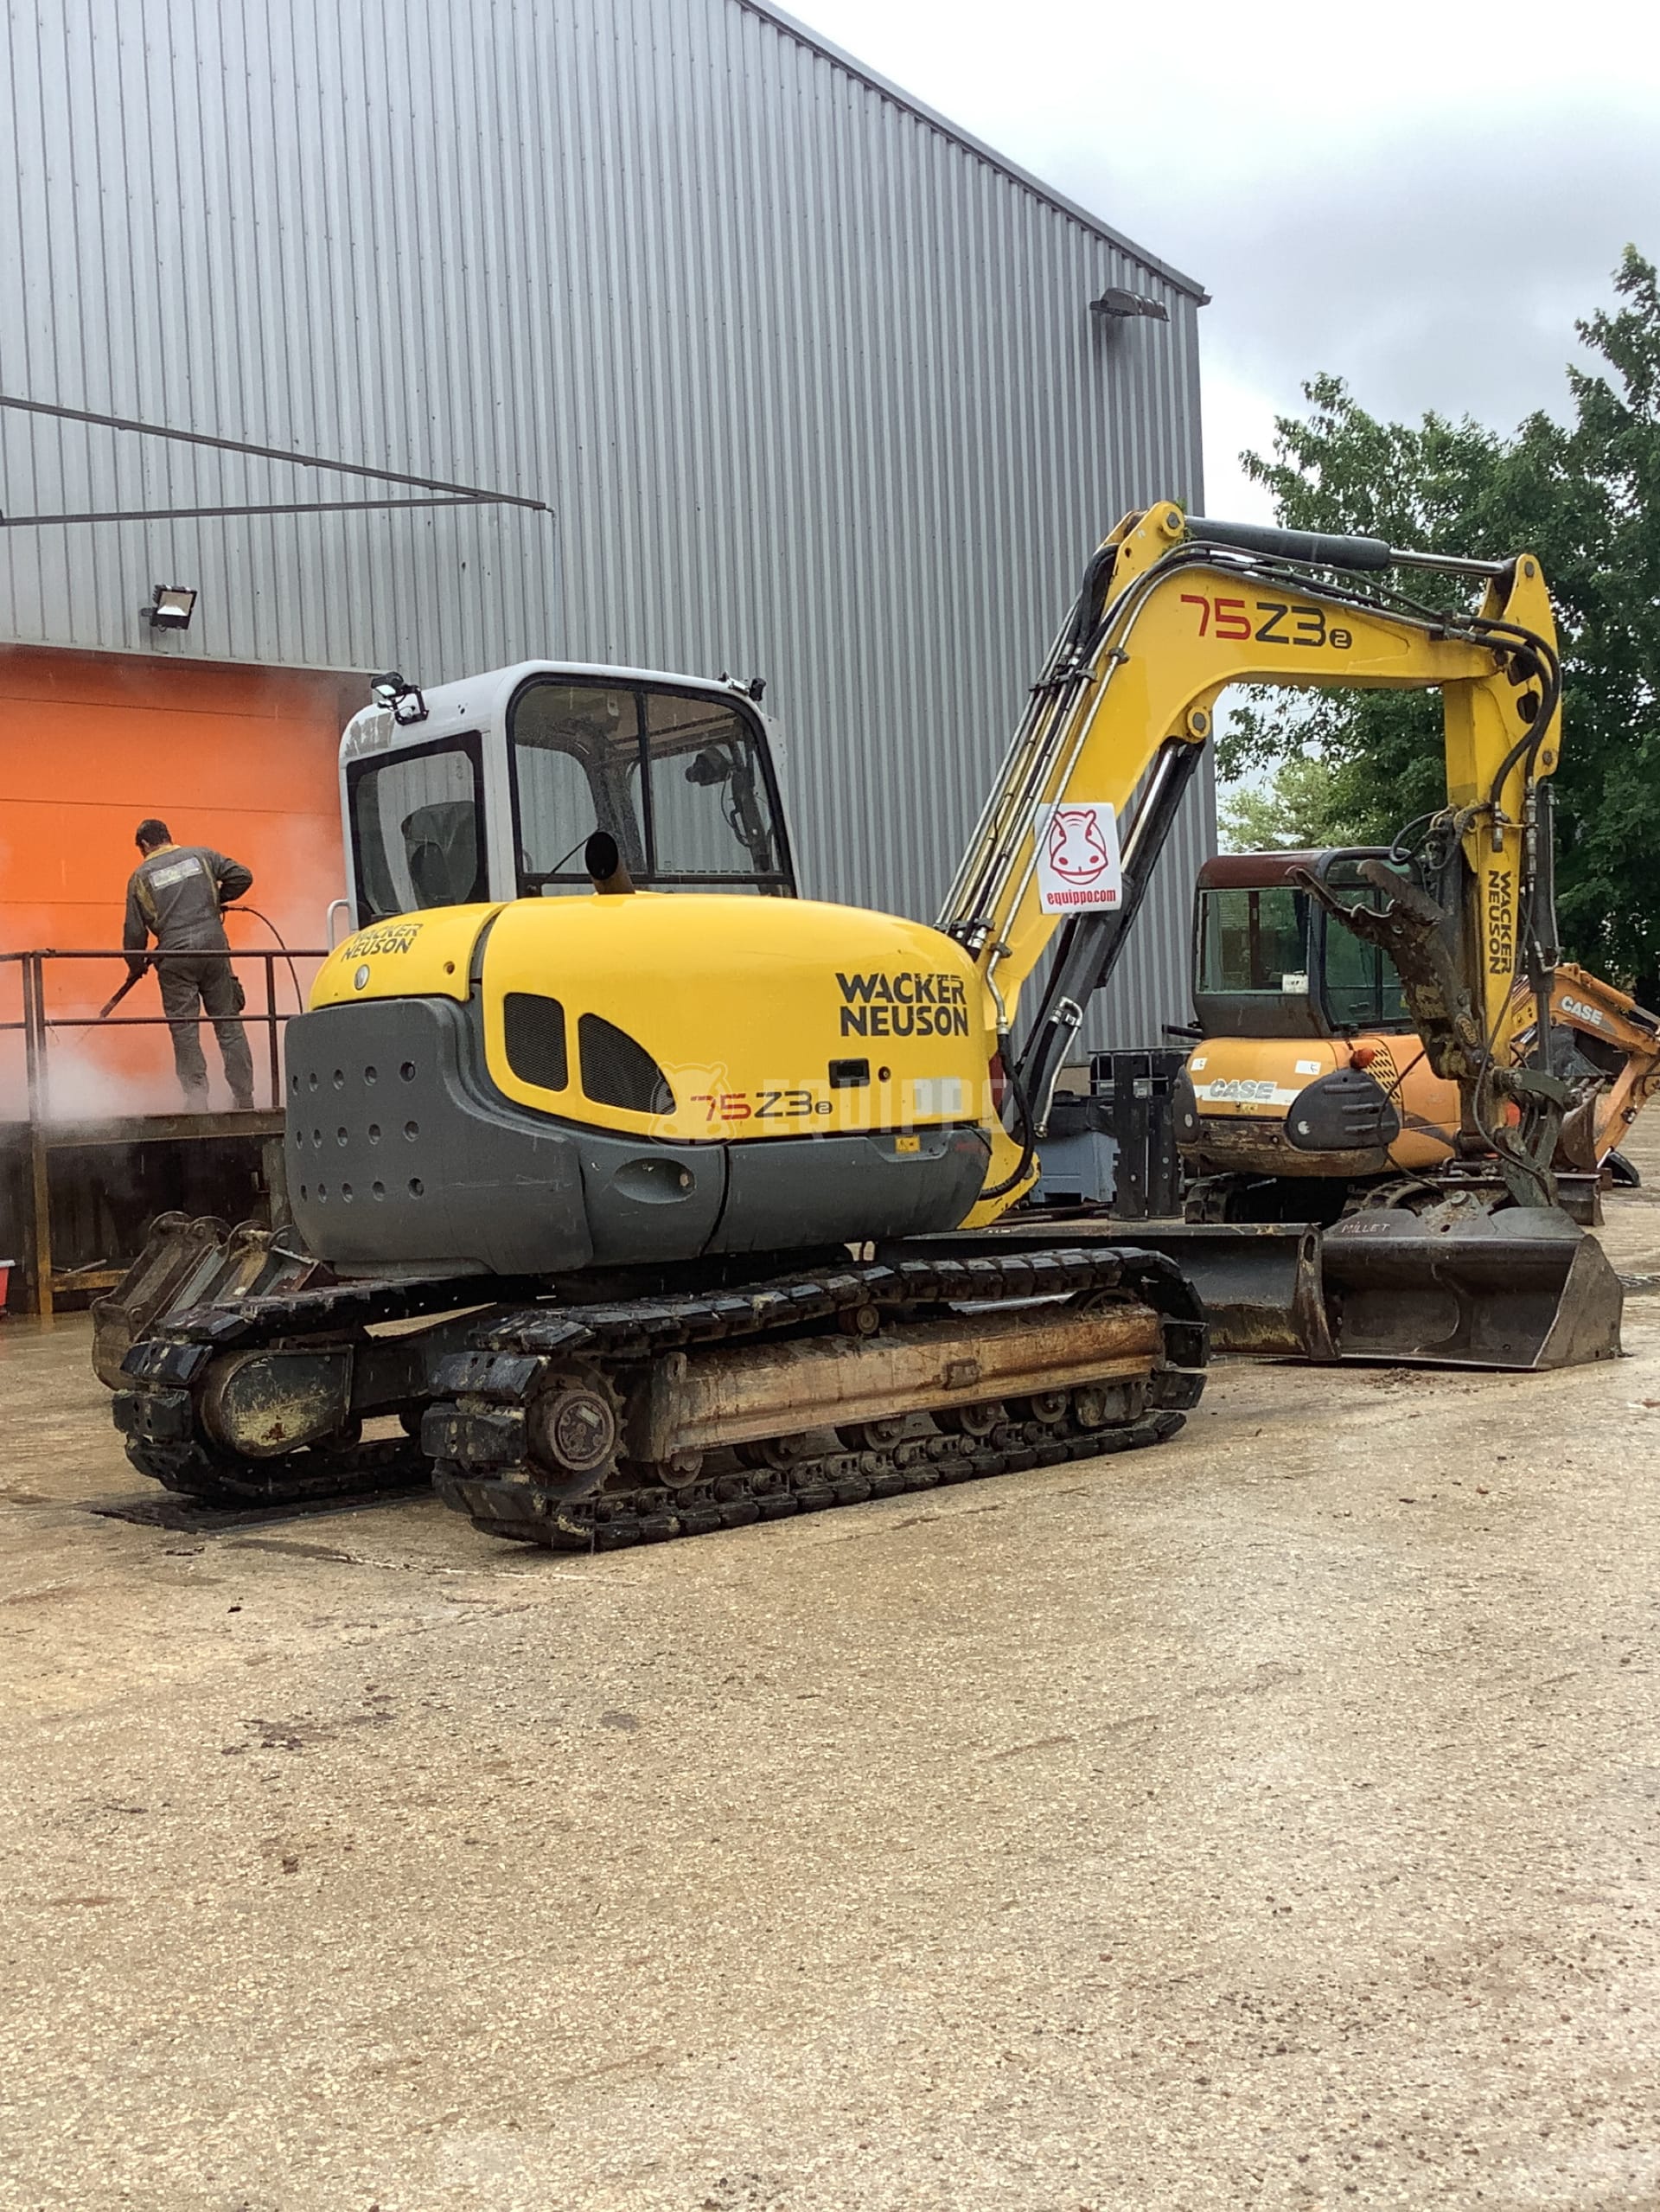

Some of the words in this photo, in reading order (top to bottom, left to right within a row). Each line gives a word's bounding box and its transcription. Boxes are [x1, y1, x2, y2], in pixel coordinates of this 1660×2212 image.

[1046, 889, 1116, 906] equippo.com
[1488, 870, 1502, 975] NEUSON
[1499, 870, 1512, 975] WACKER
[341, 937, 414, 962] NEUSON
[835, 972, 967, 1005] WACKER
[840, 1005, 969, 1037] NEUSON
[1561, 995, 1605, 1026] CASE
[1210, 1078, 1278, 1099] CASE
